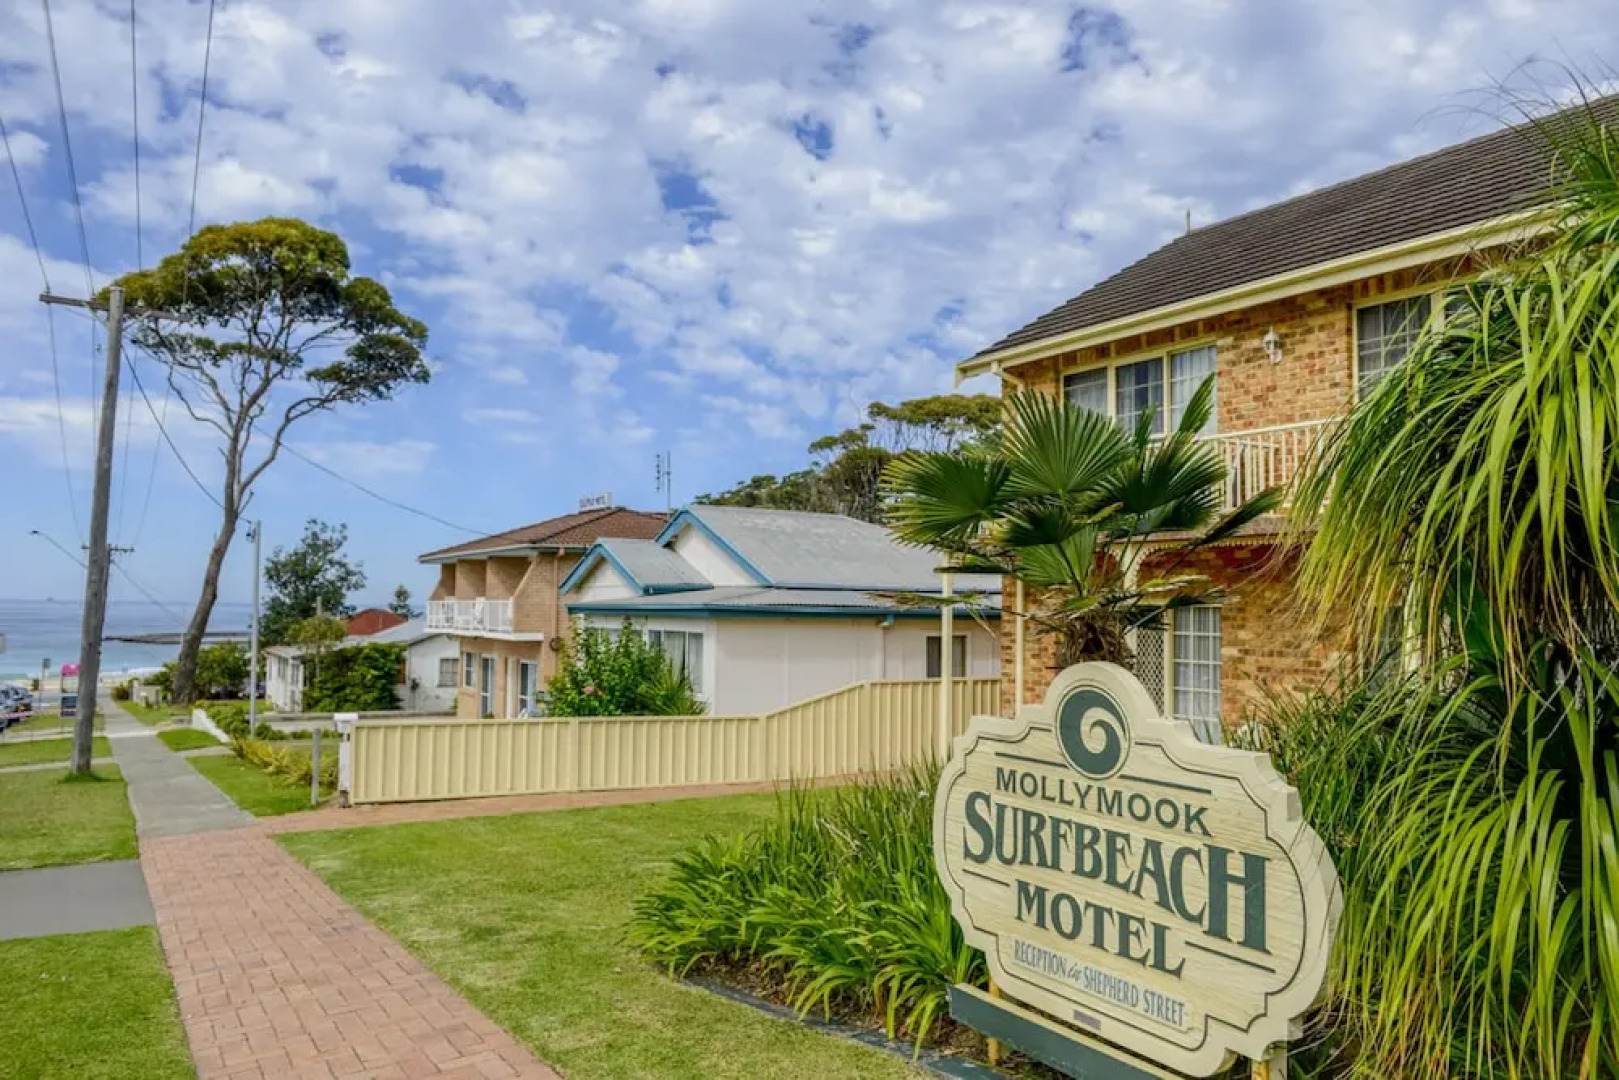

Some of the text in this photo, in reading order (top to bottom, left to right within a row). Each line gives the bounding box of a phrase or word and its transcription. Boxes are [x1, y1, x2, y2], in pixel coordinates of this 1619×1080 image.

[996, 767, 1212, 836] MOLLYMOOK
[963, 791, 1271, 955] SURFBEACH
[1015, 880, 1186, 979] MOTEL
[1014, 939, 1067, 978] RECEPTION
[1083, 966, 1139, 1008] SHEPHERD
[1143, 988, 1185, 1027] STREET
